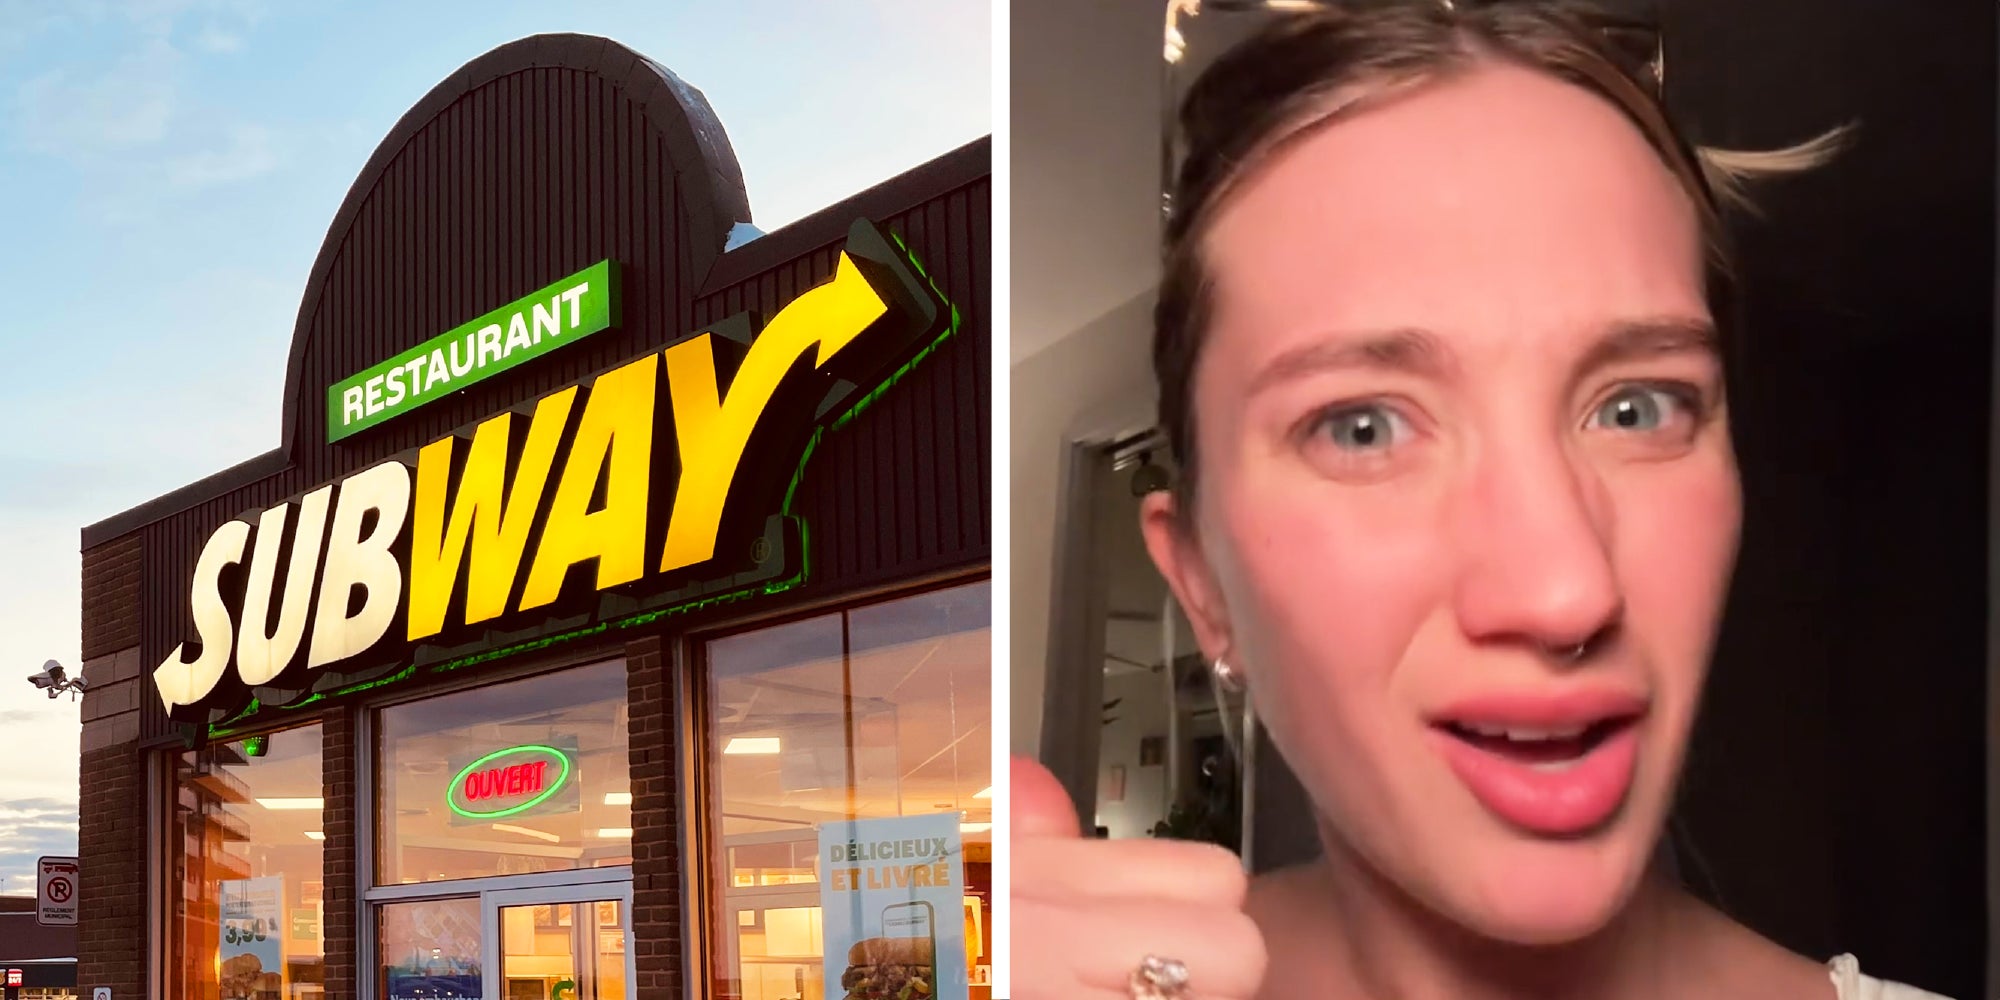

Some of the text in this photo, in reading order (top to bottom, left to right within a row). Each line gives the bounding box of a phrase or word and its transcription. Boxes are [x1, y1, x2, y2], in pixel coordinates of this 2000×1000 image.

[343, 281, 589, 426] RESTAURANT
[154, 250, 888, 718] SUBWAY
[465, 761, 548, 802] OUVERT
[830, 837, 949, 863] DÉLICIEUX
[831, 856, 951, 891] ET LIVRÉ
